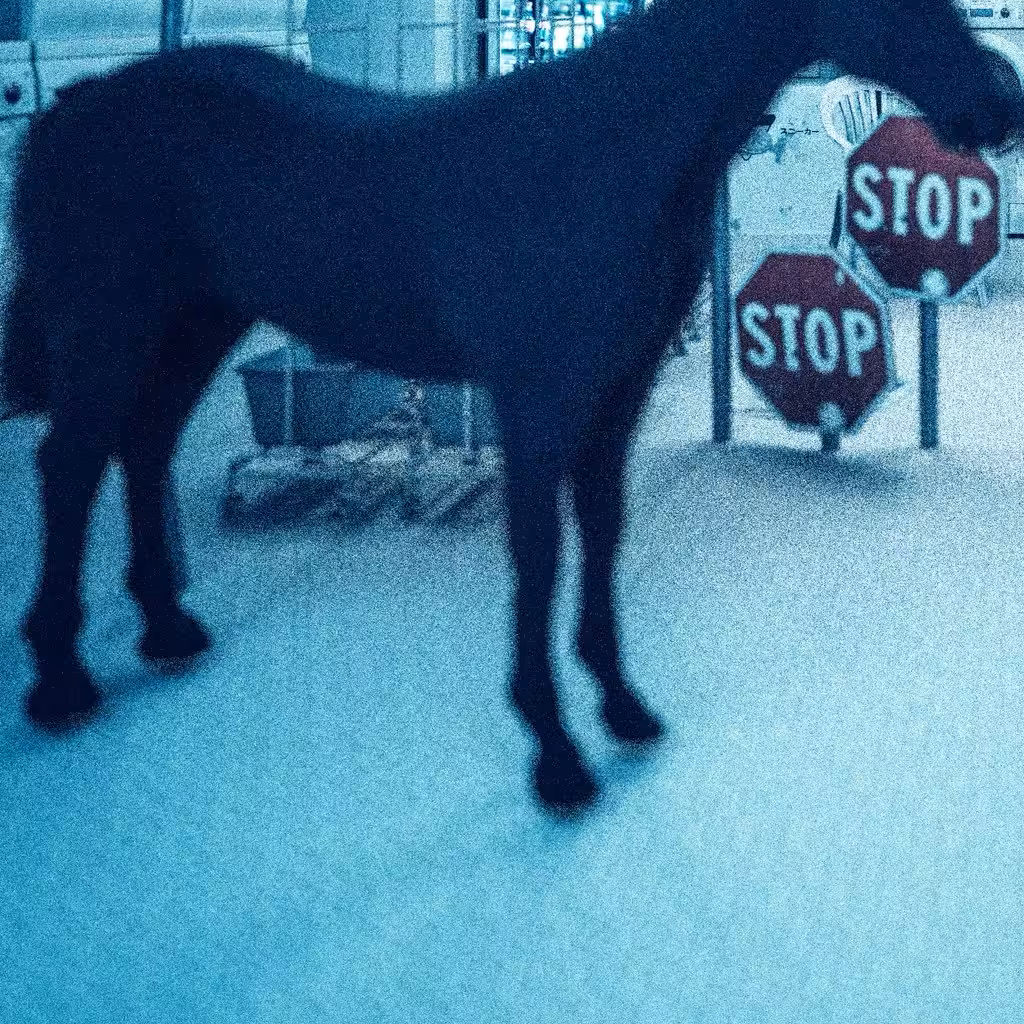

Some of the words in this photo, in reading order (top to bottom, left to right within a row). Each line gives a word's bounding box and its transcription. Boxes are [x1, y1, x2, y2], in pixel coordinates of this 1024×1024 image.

[780, 127, 820, 136] スニーカー
[851, 163, 993, 246] STOP
[740, 302, 878, 376] STOP
